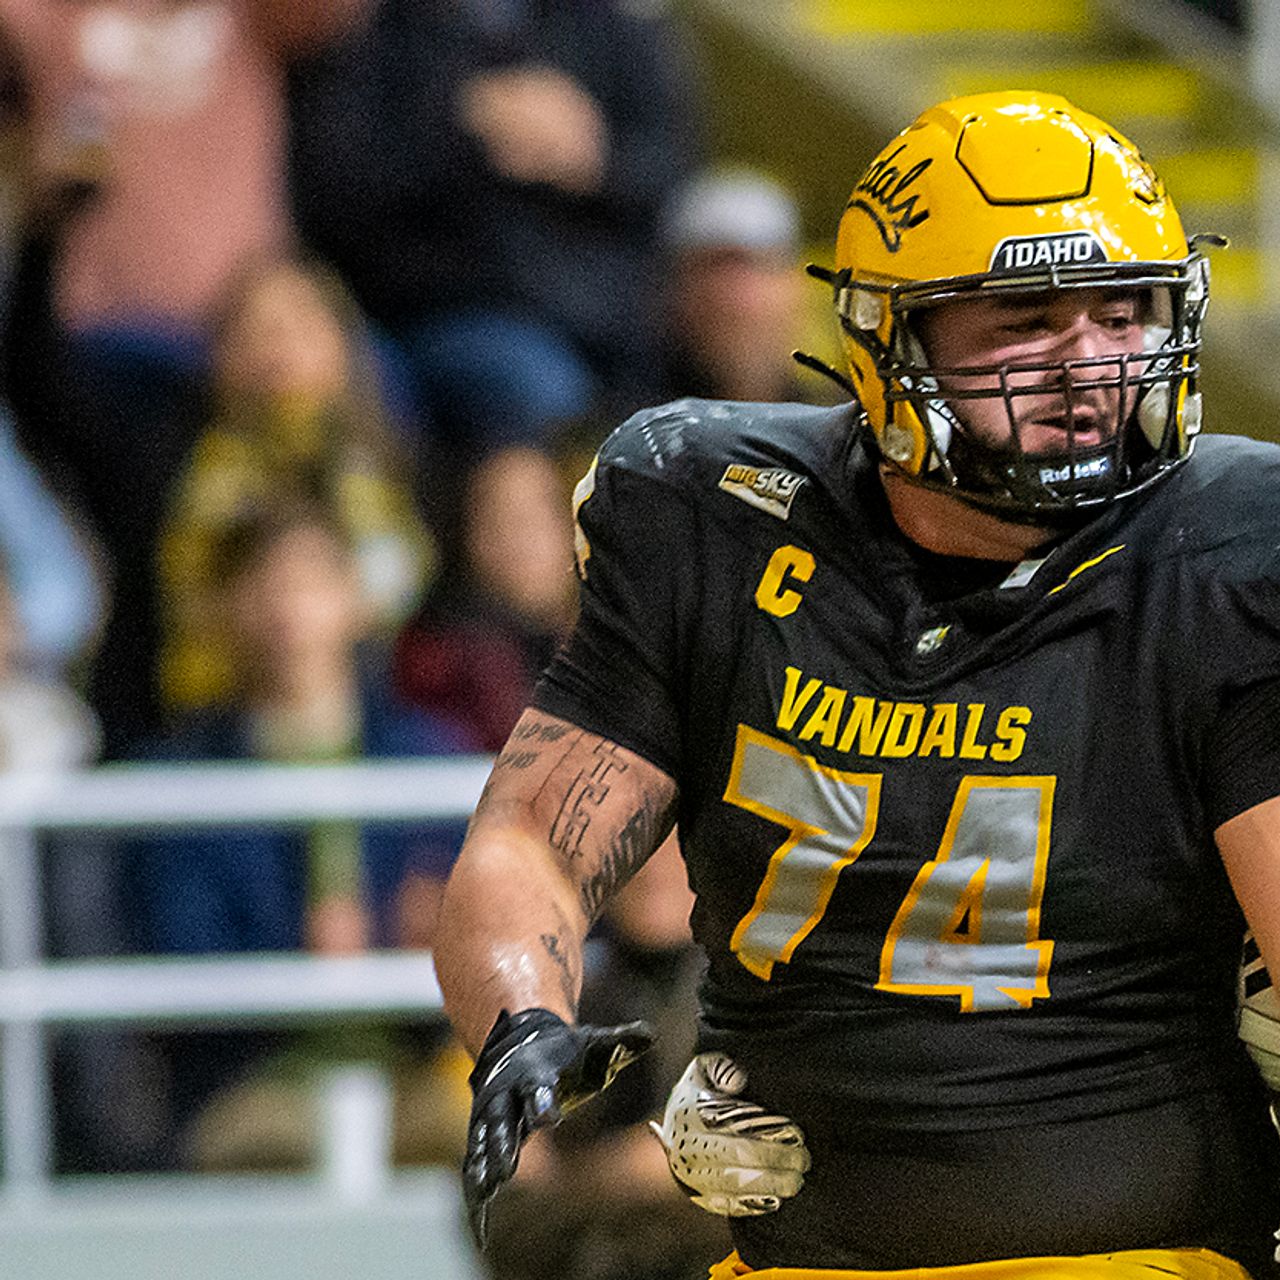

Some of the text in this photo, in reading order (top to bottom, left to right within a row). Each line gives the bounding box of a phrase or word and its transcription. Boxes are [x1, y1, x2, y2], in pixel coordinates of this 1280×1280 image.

[999, 236, 1094, 269] IDAHO
[753, 470, 802, 497] SKY
[755, 545, 816, 618] C
[776, 667, 1033, 763] VANDALS
[722, 723, 1058, 1014] 74
